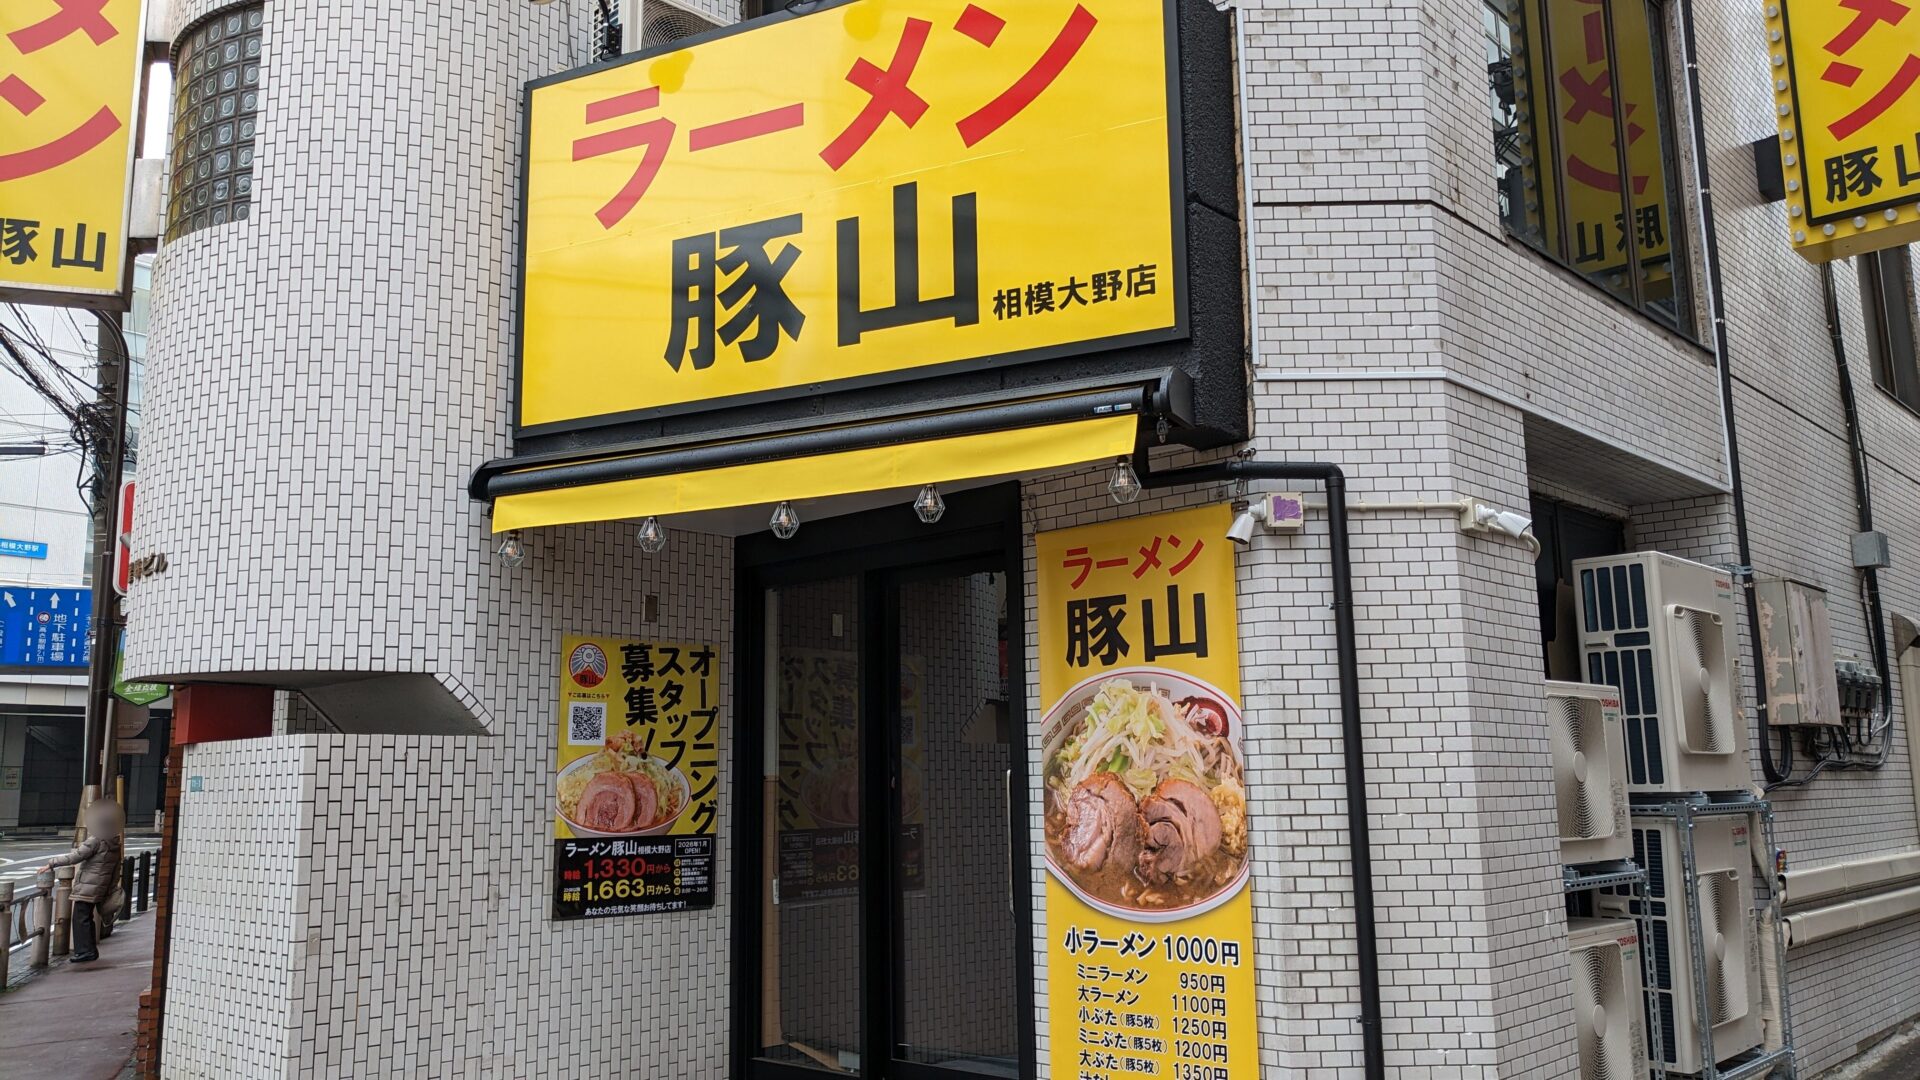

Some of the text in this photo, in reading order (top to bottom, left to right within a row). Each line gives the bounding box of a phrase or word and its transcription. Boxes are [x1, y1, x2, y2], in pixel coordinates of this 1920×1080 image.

[571, 1, 1098, 230] ラーメン
[664, 181, 980, 373] 豚山
[993, 263, 1157, 321] 相模大野店
[1063, 534, 1204, 590] ラーメン
[50, 613, 68, 662] 地下駐車場
[1066, 584, 1208, 668] 豚山
[656, 647, 688, 771] スタッフ
[688, 645, 719, 835] オープニング
[565, 840, 637, 858] ラーメン豚山
[1065, 927, 1239, 966] 小ラーメン 1000円
[1077, 963, 1225, 993] ミニラーメン 950円
[1078, 985, 1226, 1016] 大ラーメン 1100円
[1173, 1017, 1227, 1040] 1250円
[1175, 1041, 1227, 1063] 1200円
[1174, 1063, 1228, 1080] 1350円
